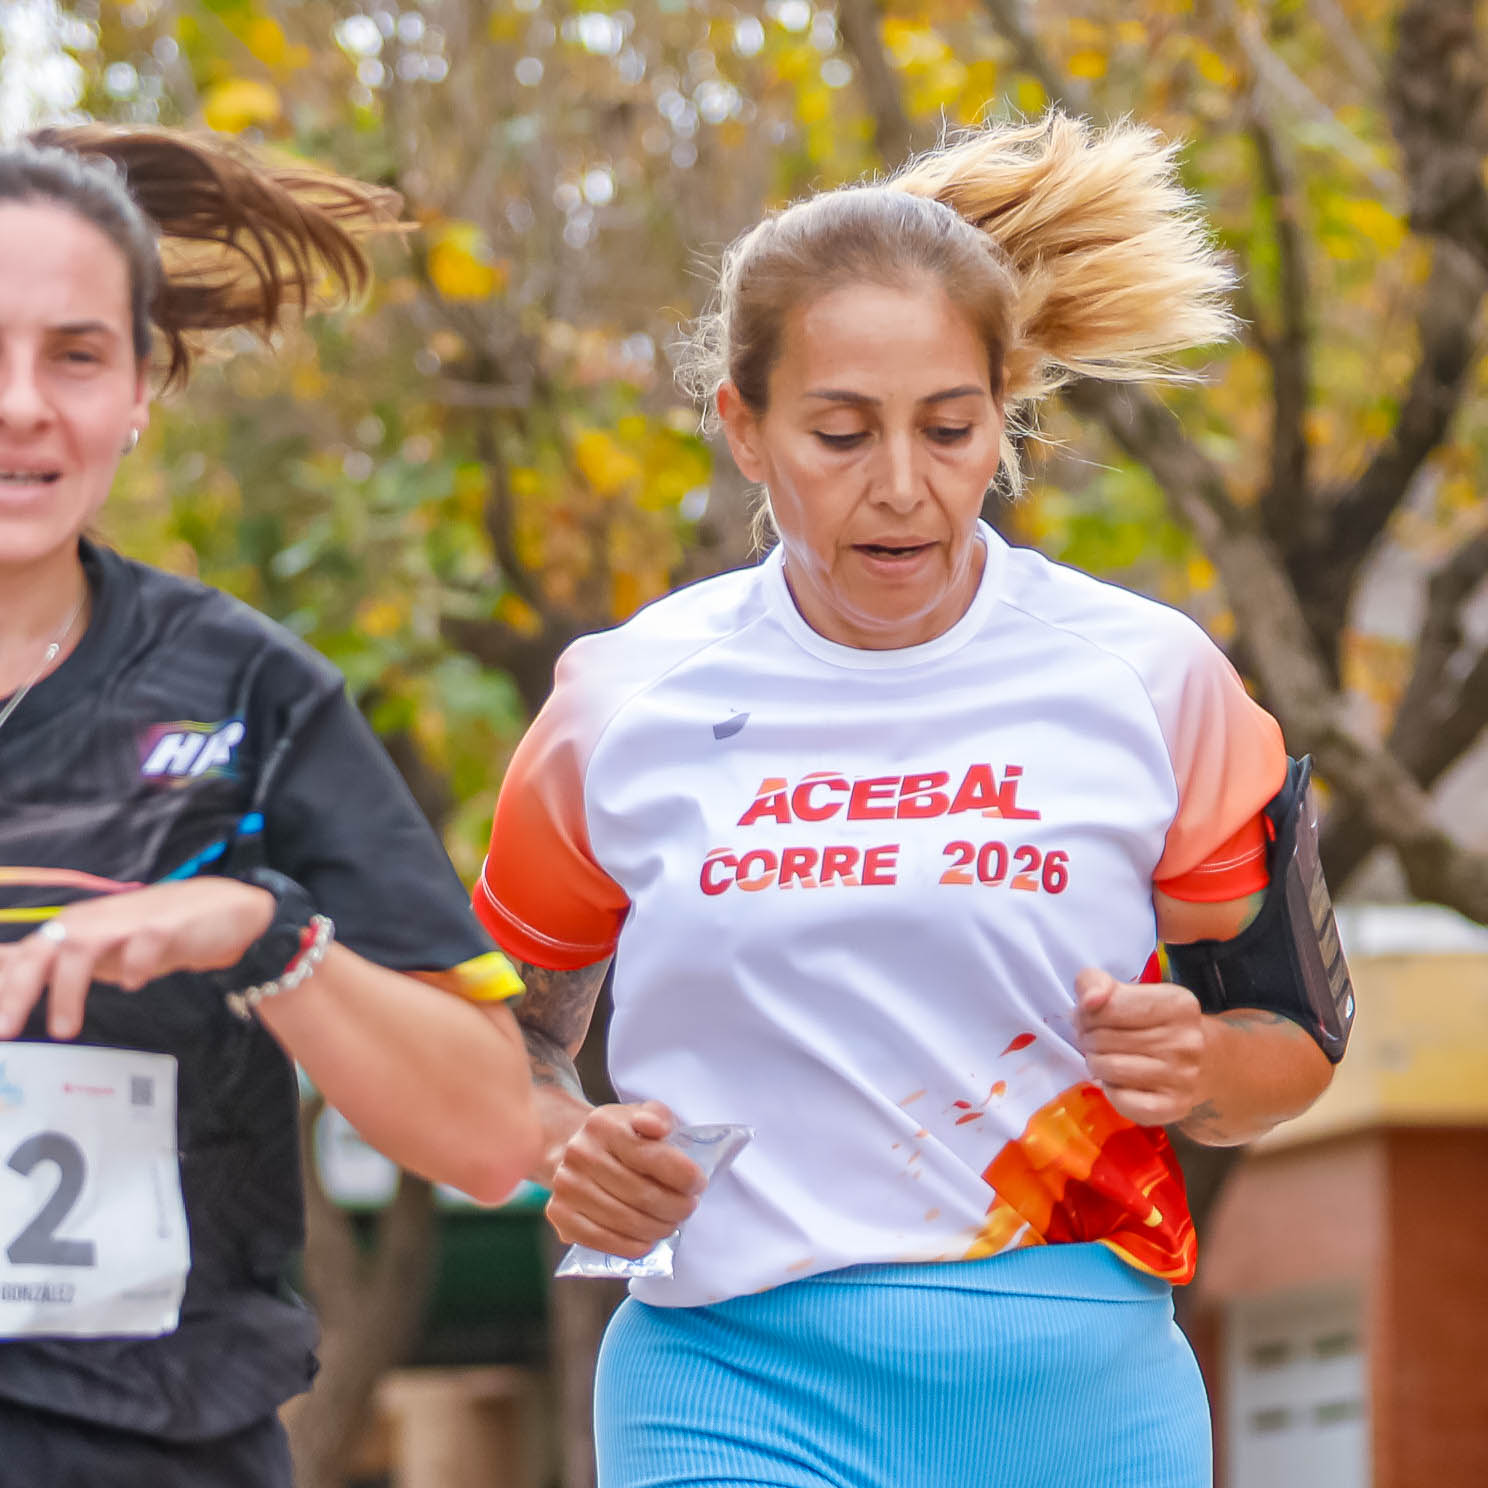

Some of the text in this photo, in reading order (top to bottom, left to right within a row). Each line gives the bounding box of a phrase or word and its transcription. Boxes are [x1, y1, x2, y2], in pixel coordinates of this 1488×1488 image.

[736, 763, 1042, 826] ACEBAL
[699, 840, 1070, 896] CORRE 2026
